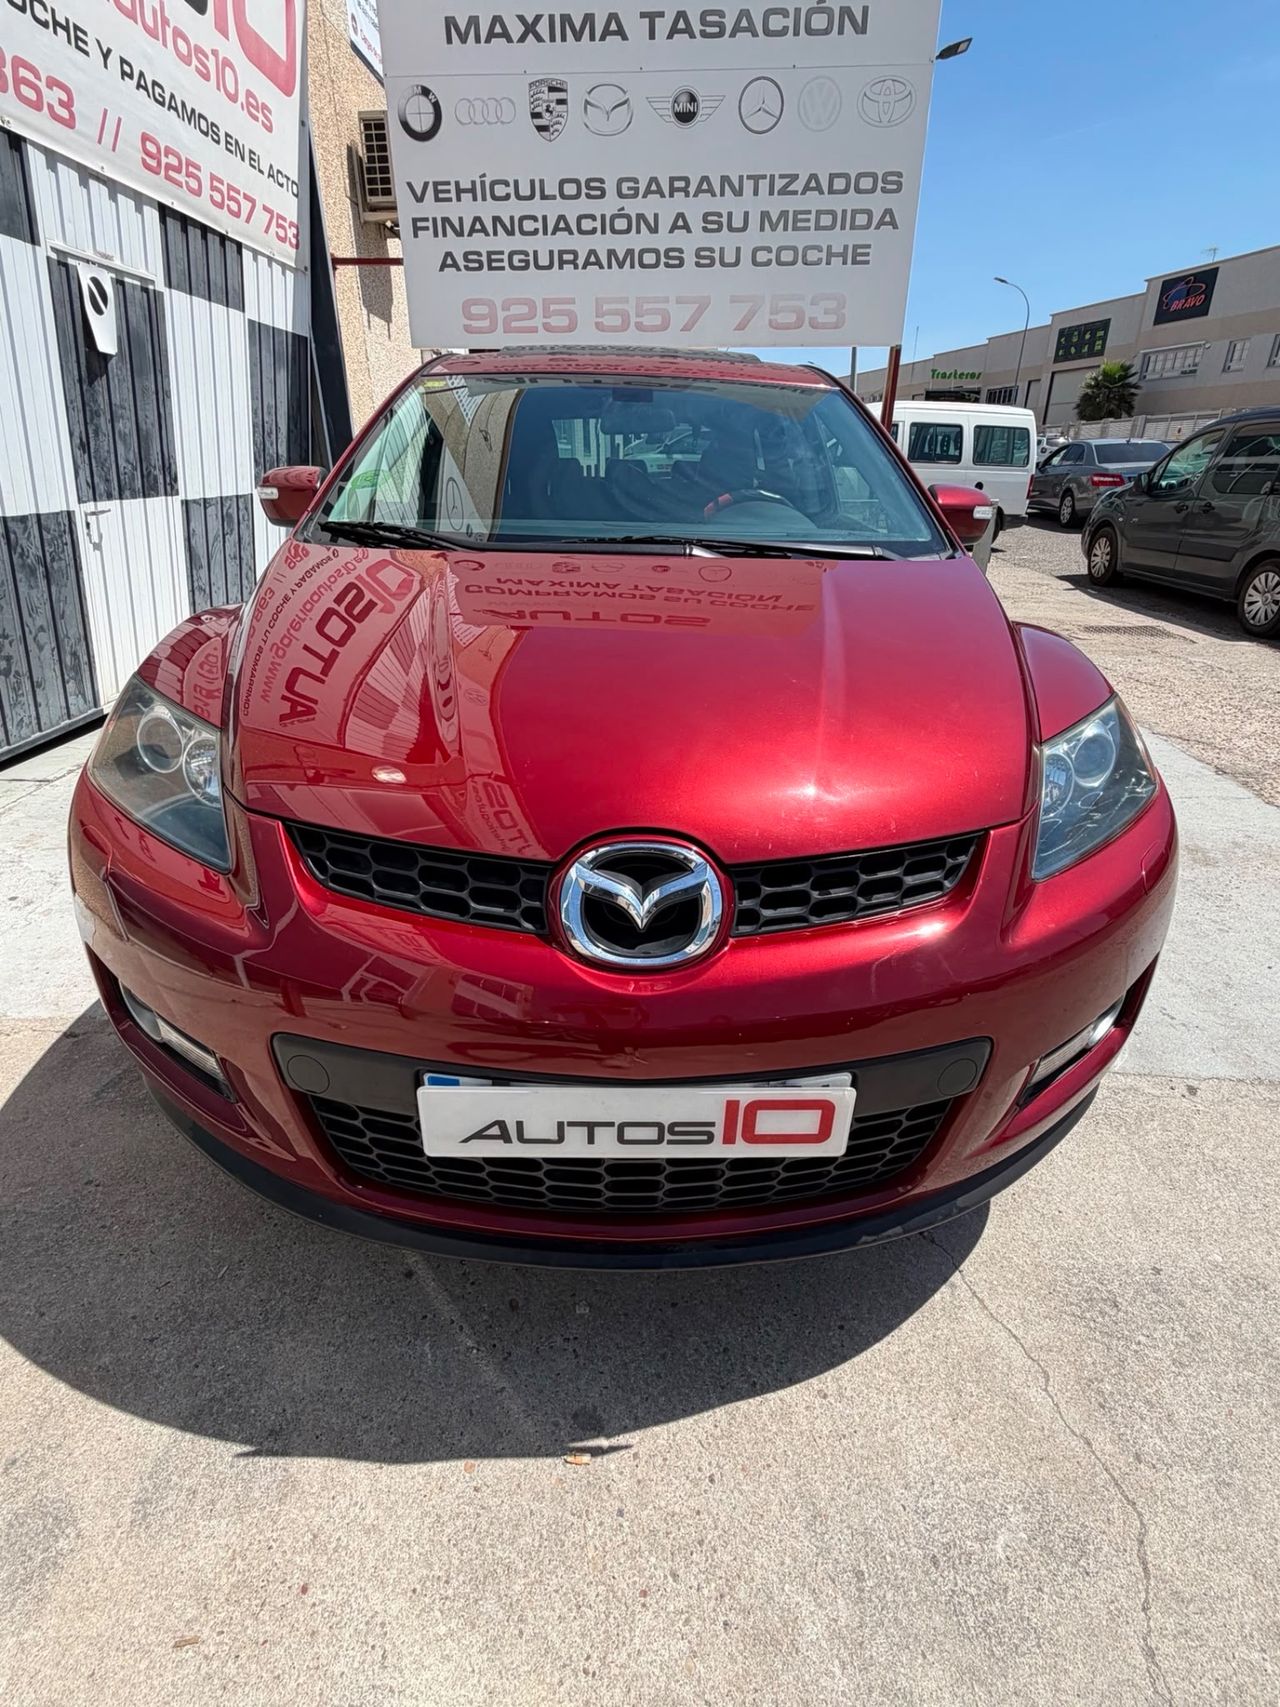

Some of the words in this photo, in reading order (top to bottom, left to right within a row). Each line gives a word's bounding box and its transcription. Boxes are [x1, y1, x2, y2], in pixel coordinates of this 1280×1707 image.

[444, 12, 629, 45] MAXIMA
[640, 0, 869, 40] TASACIÓN
[112, 0, 273, 133] autos10.es
[95, 38, 113, 70] Y
[119, 55, 221, 146] PAGAMOS
[224, 131, 246, 163] EN
[249, 148, 265, 175] EL
[267, 163, 299, 200] ACTO
[674, 102, 698, 113] MINI
[0, 46, 76, 130] 63
[141, 131, 203, 198] 925
[209, 171, 257, 224] 557
[262, 203, 299, 249] 753
[406, 172, 607, 203] VEHÍCULOS
[616, 170, 904, 200] GARANTIZADOS
[411, 206, 659, 238] FINANCIACIÓN
[668, 212, 693, 234] A
[701, 211, 749, 233] SU
[759, 208, 899, 232] MEDIDA
[439, 247, 685, 273] ASEGURAMOS
[694, 246, 742, 268] SU
[751, 244, 872, 267] COCHE
[461, 297, 579, 335] 925
[594, 295, 712, 333] 557
[729, 293, 847, 332] 753
[1170, 294, 1206, 312] BRAVO
[459, 1099, 836, 1146] AUTOS10
